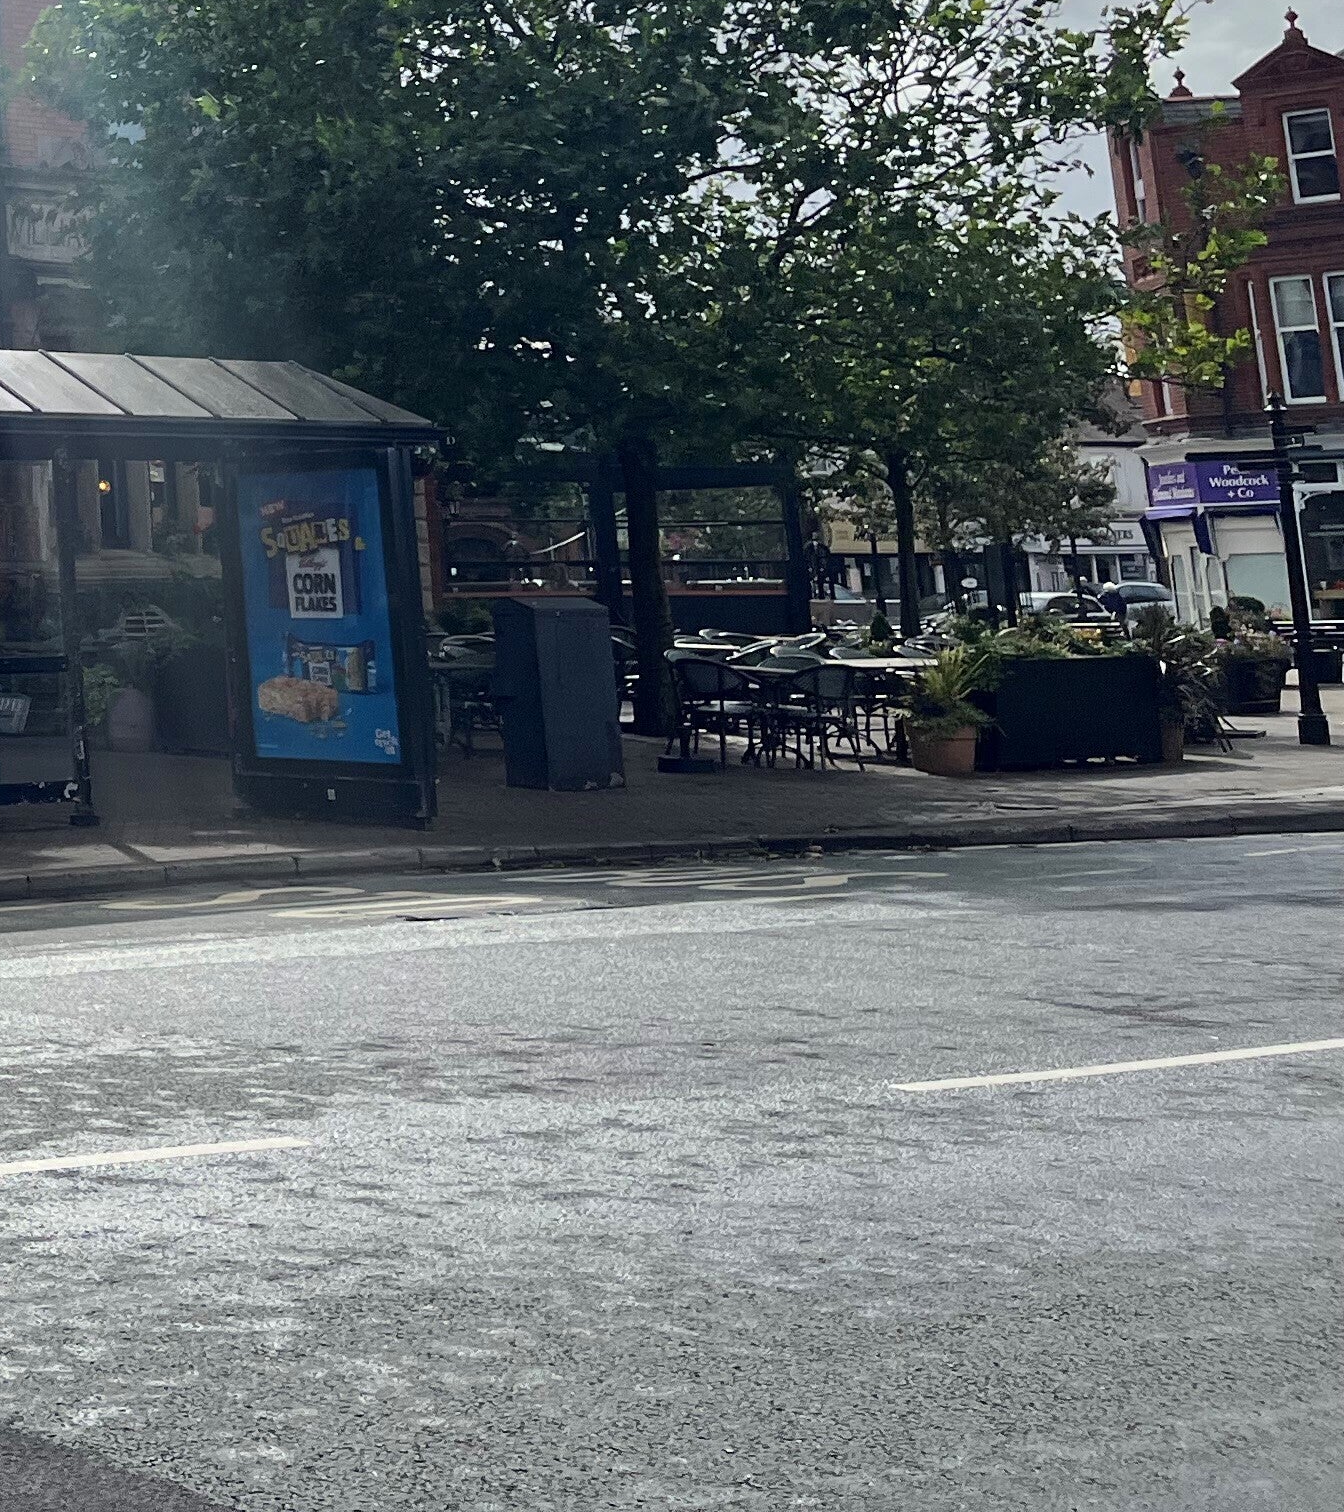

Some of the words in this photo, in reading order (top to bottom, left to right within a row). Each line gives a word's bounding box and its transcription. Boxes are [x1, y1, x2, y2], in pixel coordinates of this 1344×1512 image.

[1208, 474, 1270, 488] Woodcock
[1237, 487, 1255, 499] Co
[292, 572, 337, 596] CORN
[294, 596, 338, 613] FLAKES
